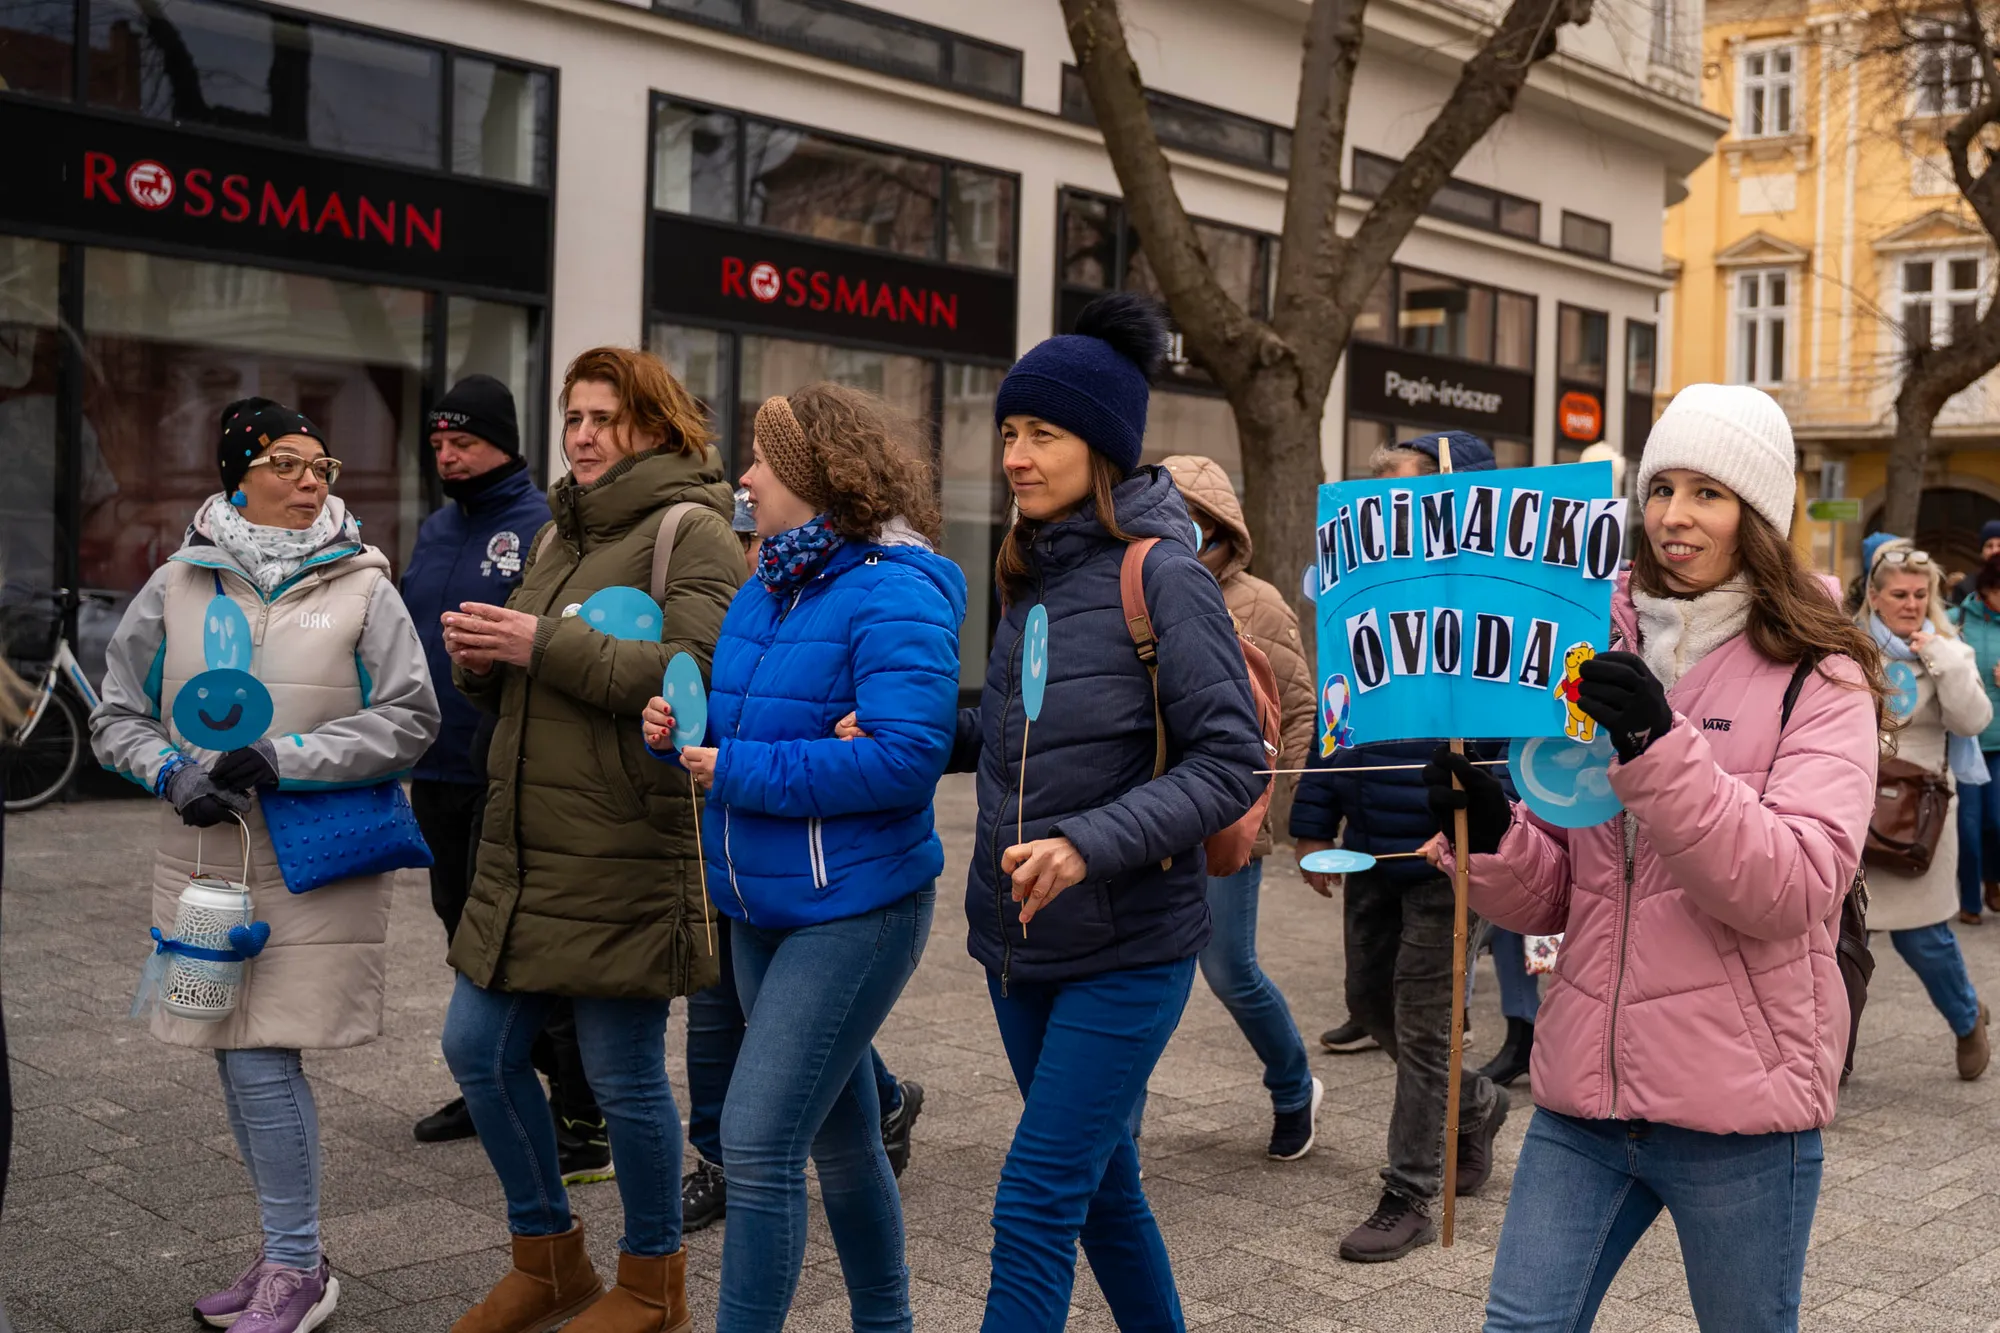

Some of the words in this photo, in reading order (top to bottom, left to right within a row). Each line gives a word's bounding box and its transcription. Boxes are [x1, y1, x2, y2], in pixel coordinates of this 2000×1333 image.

[84, 151, 442, 251] ROSSMANN
[721, 256, 957, 329] ROSSMANN
[1352, 609, 1552, 688] ÓVODA
[1702, 718, 1732, 731] VANS
